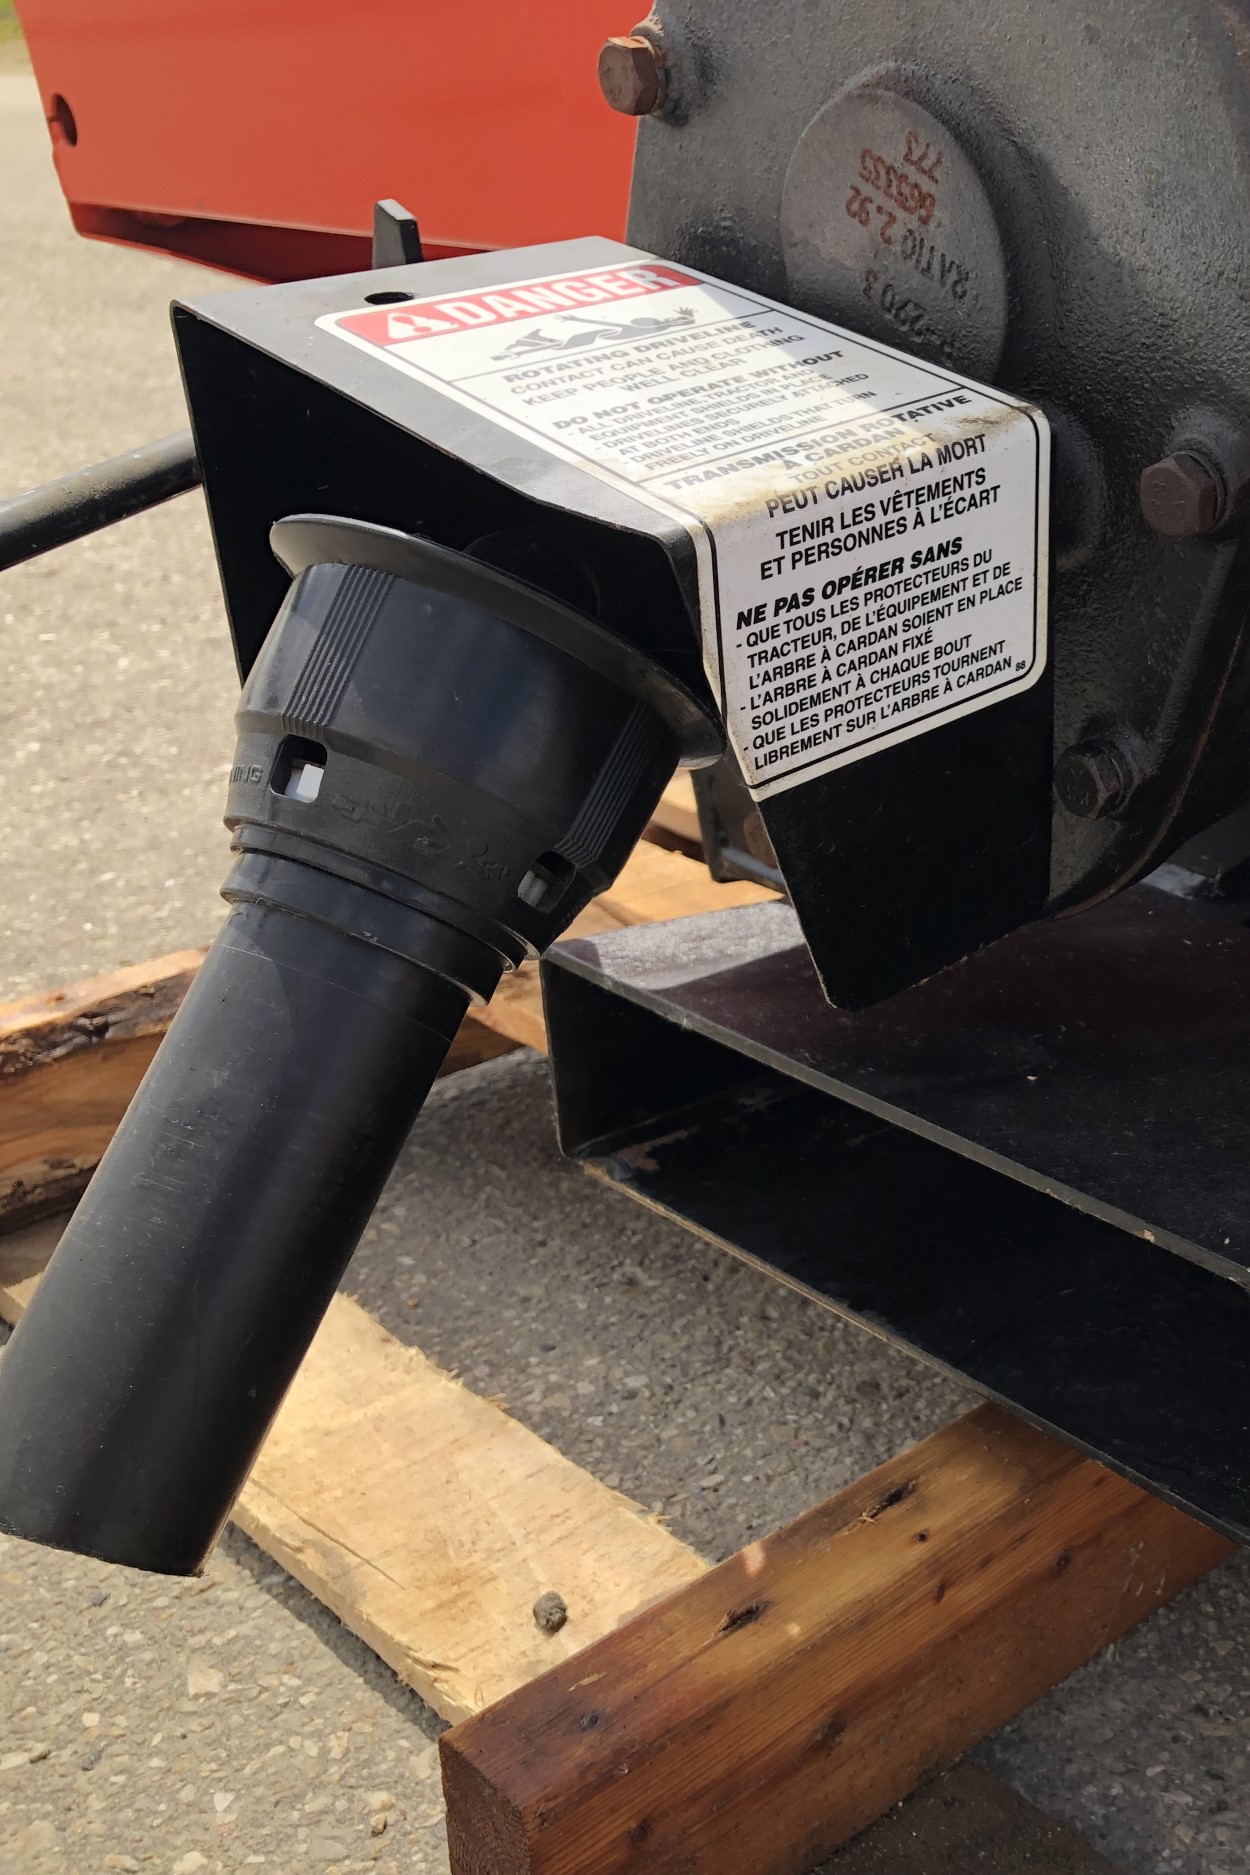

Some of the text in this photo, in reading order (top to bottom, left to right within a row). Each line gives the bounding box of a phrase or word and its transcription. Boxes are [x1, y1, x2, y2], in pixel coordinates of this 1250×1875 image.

[436, 265, 680, 327] DANGER
[500, 321, 758, 383] ROTATING DRIVELINE
[506, 326, 786, 395] CONTACT CAN CAUSE DEATH
[520, 334, 807, 406] KEEP PEOPLE AND CLOTHING
[550, 350, 849, 429] DO NOT OPERATE WITHOUT
[618, 357, 749, 392] WELL CLEAR
[587, 372, 835, 441] EQUIPMENT SHIELDS IN PLACE
[600, 416, 707, 449] DRIVELINES
[702, 393, 792, 421] SECURELY
[787, 372, 872, 398] ATTACHED
[615, 417, 742, 456] AT BOTH ENDS
[629, 433, 725, 464] DRIVELINE
[720, 413, 796, 438] SHIELDS
[789, 402, 837, 418] THAT
[831, 390, 879, 406] TURN
[643, 414, 828, 471] FREELY ON DRIVELINE
[663, 394, 975, 492] TRANSMISSION ROTATIVE
[765, 434, 985, 520] PEUT CAUSER LA MORT
[773, 426, 908, 470] À CARDAN
[787, 432, 942, 485] TOUT CONTACT
[759, 484, 1000, 580] ET PERSONNES À L'ÉCART
[775, 467, 986, 551] TENIR LES VÊTEMENTS
[735, 536, 962, 630] NE PAS OPÉRER SANS
[745, 622, 781, 648] QUE
[782, 606, 826, 636] TOUS
[830, 595, 859, 619] LES
[864, 557, 969, 607] PROTECTEURS
[973, 549, 992, 569] DU
[747, 561, 1011, 672] TRACTEUR, DE L'ÉQUIPEMENT ET DE
[749, 577, 1023, 689] L'ARBRE À CARDAN SOIENT EN PLACE
[750, 672, 817, 710] L'ARBRE
[821, 664, 832, 683] À
[836, 642, 898, 678] CARDAN
[902, 625, 933, 653] FIXÉ
[751, 634, 971, 731] SOLIDEMENT À CHAQUE BOUT
[752, 724, 786, 751] QUE
[790, 711, 819, 736] LES
[824, 668, 930, 723] PROTECTEURS
[932, 640, 1005, 681] TOURNENT
[754, 656, 1011, 770] LIBREMENT SUR L'ARBRE À CARDAN
